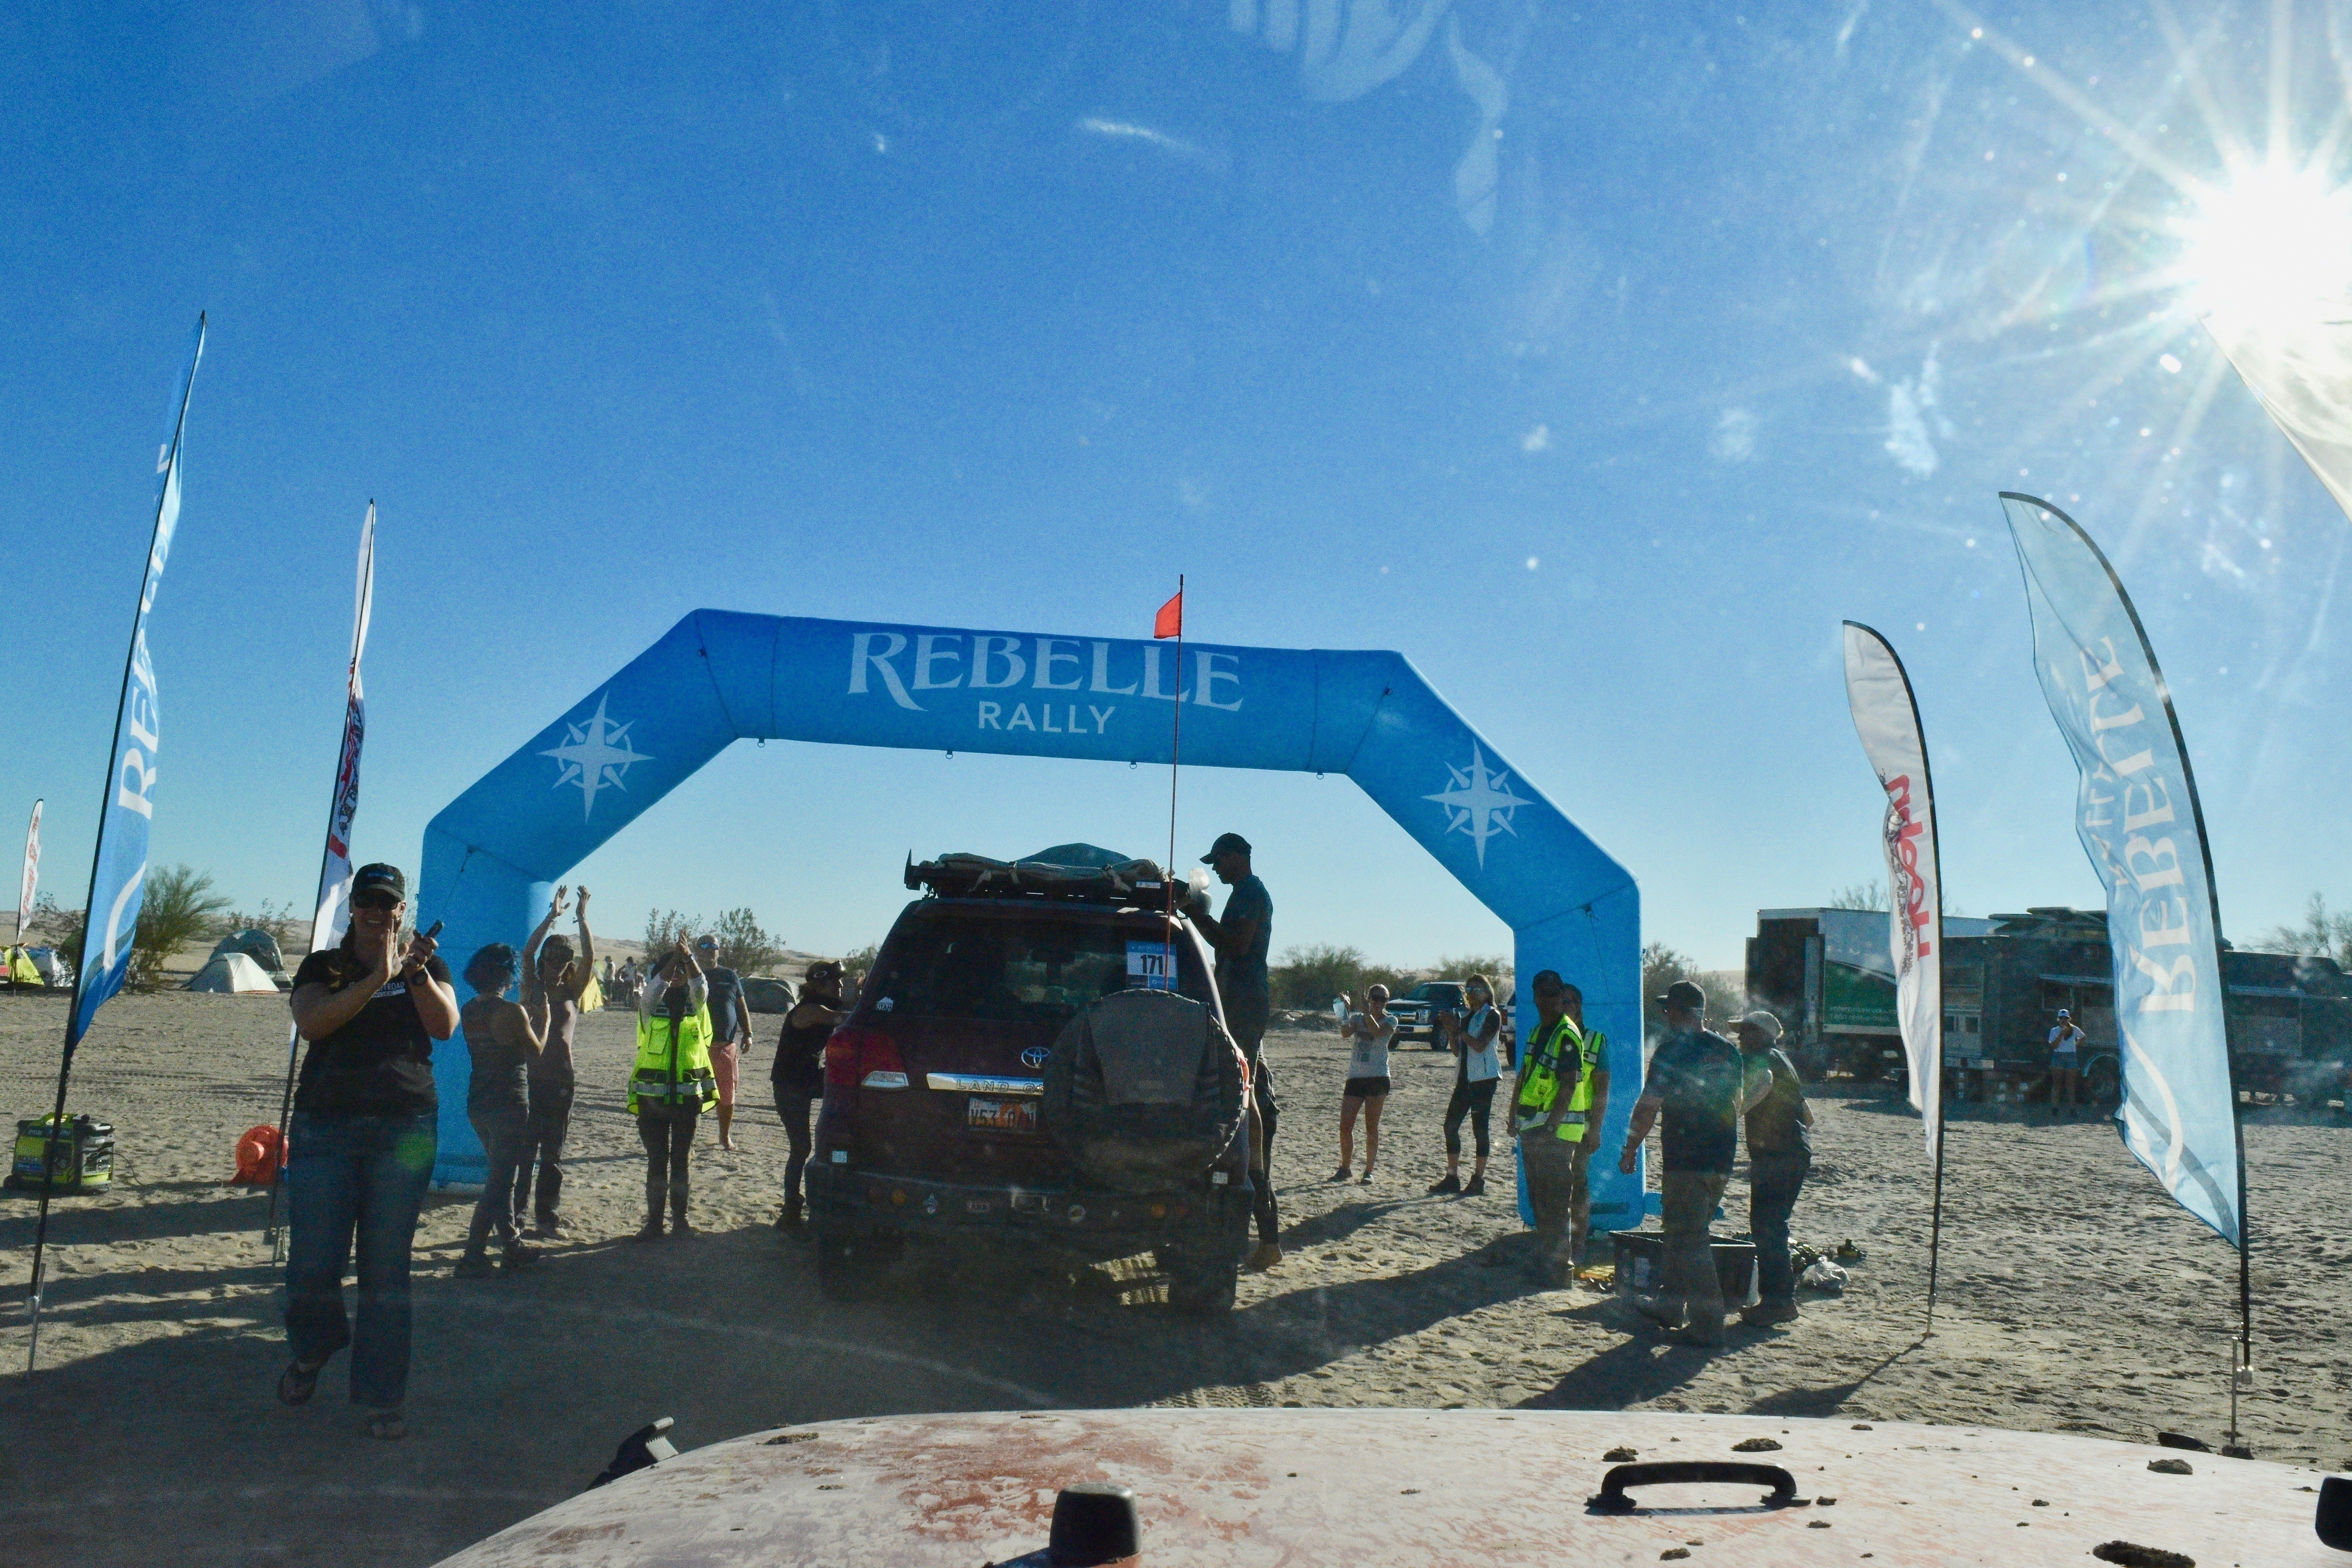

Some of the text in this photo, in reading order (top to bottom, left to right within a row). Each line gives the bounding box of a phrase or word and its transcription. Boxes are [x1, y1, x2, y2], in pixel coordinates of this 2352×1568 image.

[847, 632, 1244, 712] REBELLE
[978, 701, 1116, 734] RALLY
[1140, 954, 1163, 975] 171
[956, 1079, 1009, 1092] LAND
